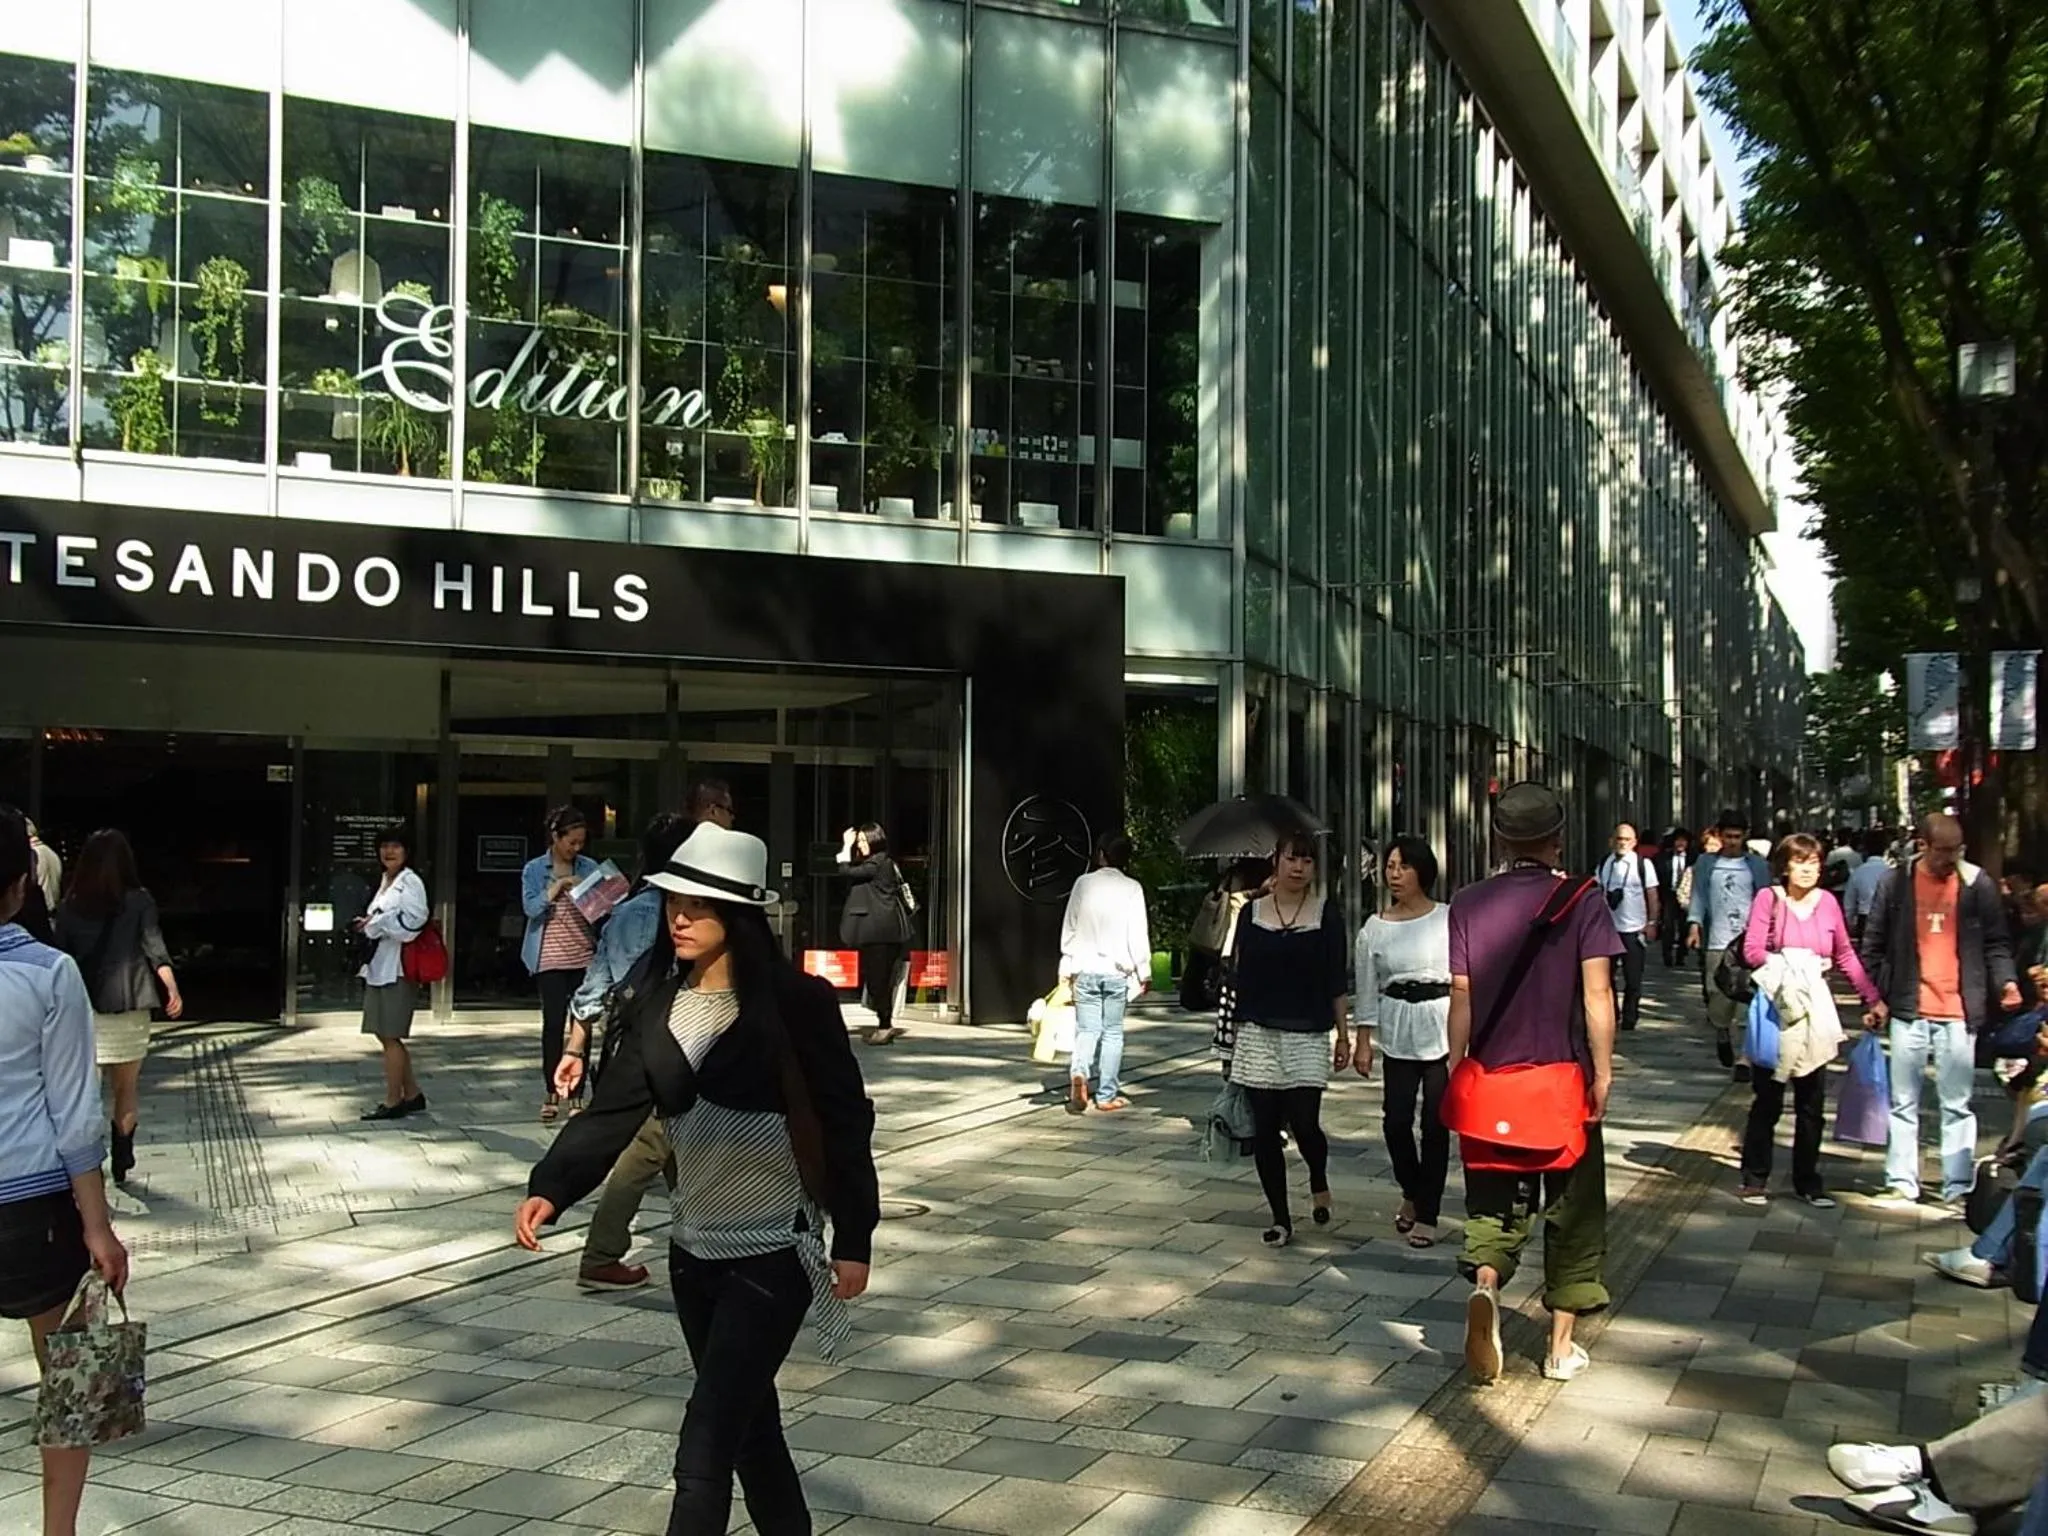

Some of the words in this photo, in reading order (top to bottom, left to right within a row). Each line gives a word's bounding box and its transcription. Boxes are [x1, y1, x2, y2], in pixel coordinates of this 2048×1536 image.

[355, 293, 712, 429] Edition
[0, 532, 401, 607] TESANDO
[433, 562, 649, 623] HILLS
